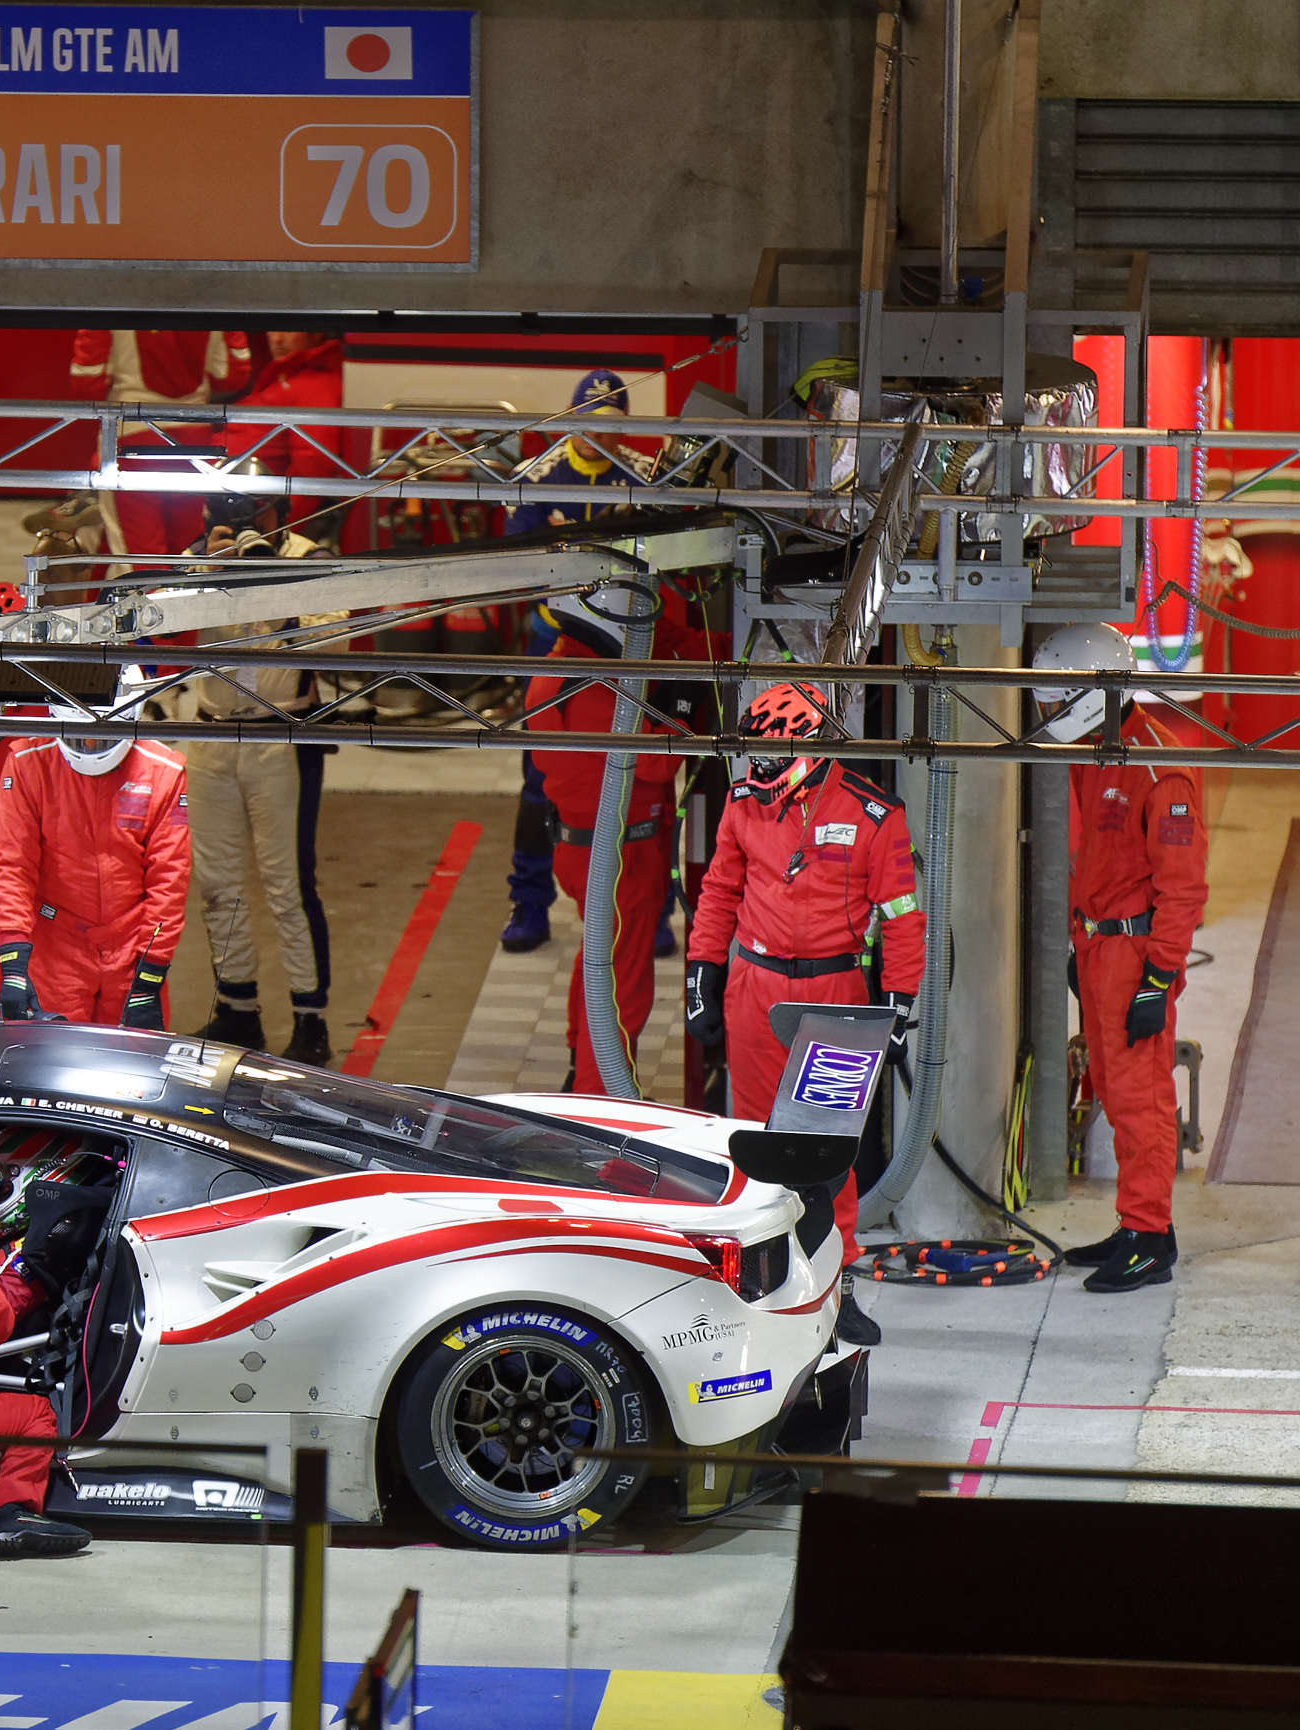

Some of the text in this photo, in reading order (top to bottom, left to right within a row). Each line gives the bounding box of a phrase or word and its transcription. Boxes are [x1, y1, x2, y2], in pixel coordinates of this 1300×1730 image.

[52, 27, 114, 73] GTE
[124, 28, 179, 73] AM
[306, 143, 431, 229] 70
[801, 1048, 872, 1109] CORNES
[38, 1099, 124, 1119] E. CHEVEER
[149, 1119, 231, 1150] O. BERETTA
[36, 1188, 61, 1200] OMP
[482, 1311, 588, 1342] MICHELIN
[662, 1327, 715, 1351] MPMG
[720, 1321, 746, 1331] Partners
[717, 1378, 765, 1394] MICHELIN
[76, 1482, 172, 1500] pakelo
[455, 1510, 560, 1542] MICHELIN
